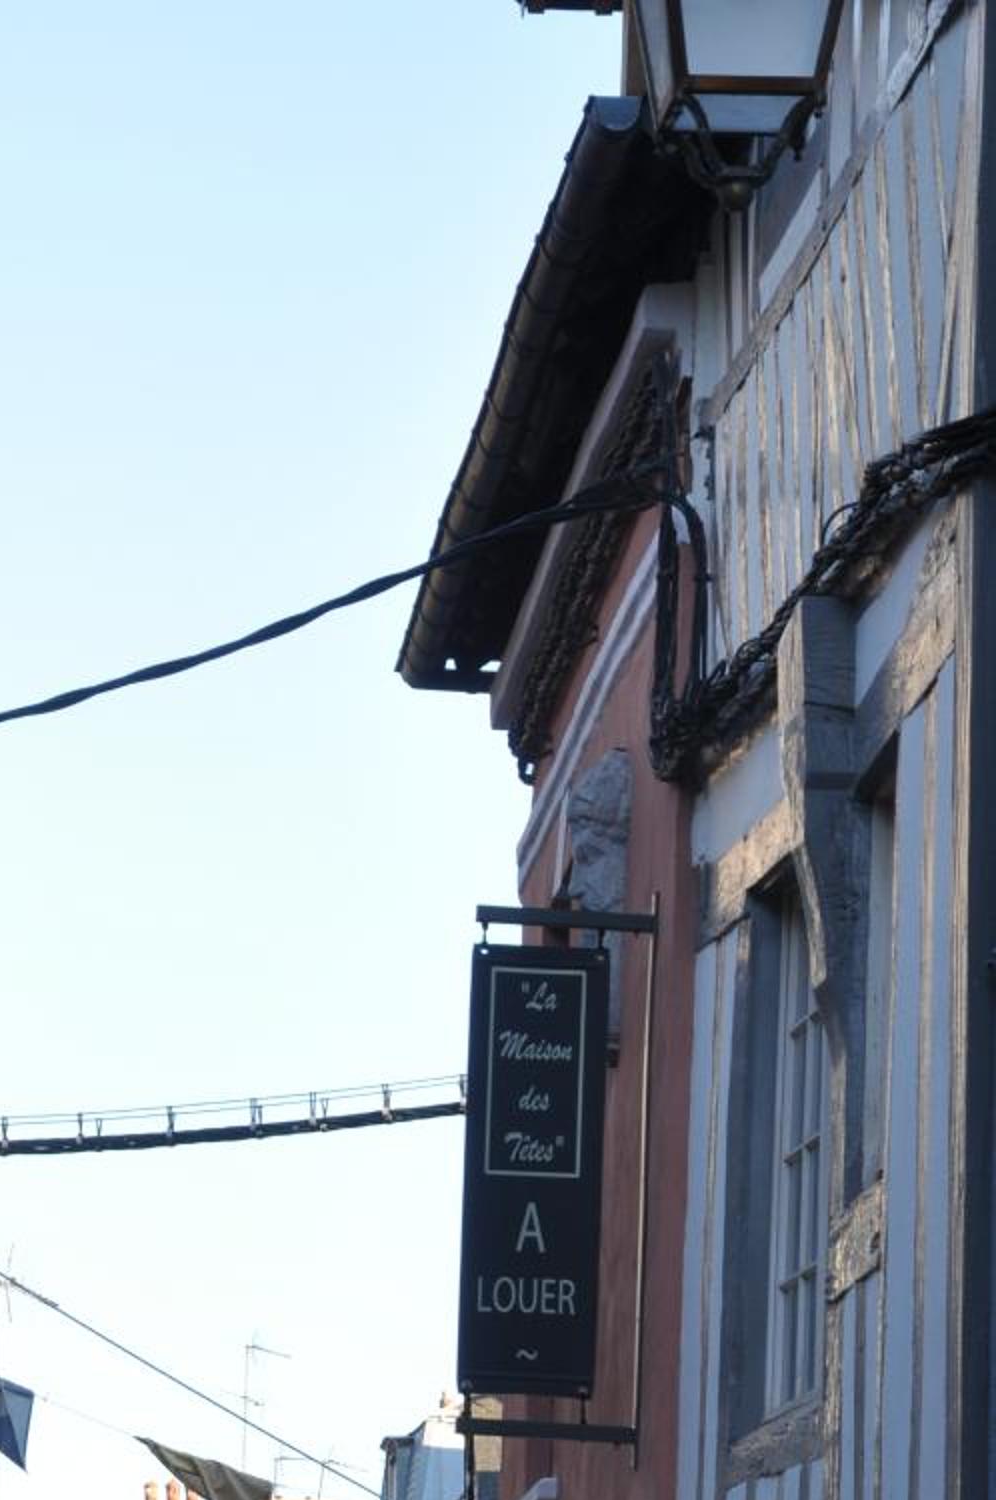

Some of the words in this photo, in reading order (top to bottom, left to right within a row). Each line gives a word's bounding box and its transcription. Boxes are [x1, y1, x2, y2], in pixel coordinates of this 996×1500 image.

[498, 1029, 574, 1061] Maison
[517, 1084, 551, 1112] des
[515, 1202, 546, 1254] A
[477, 1276, 576, 1316] LOUER
